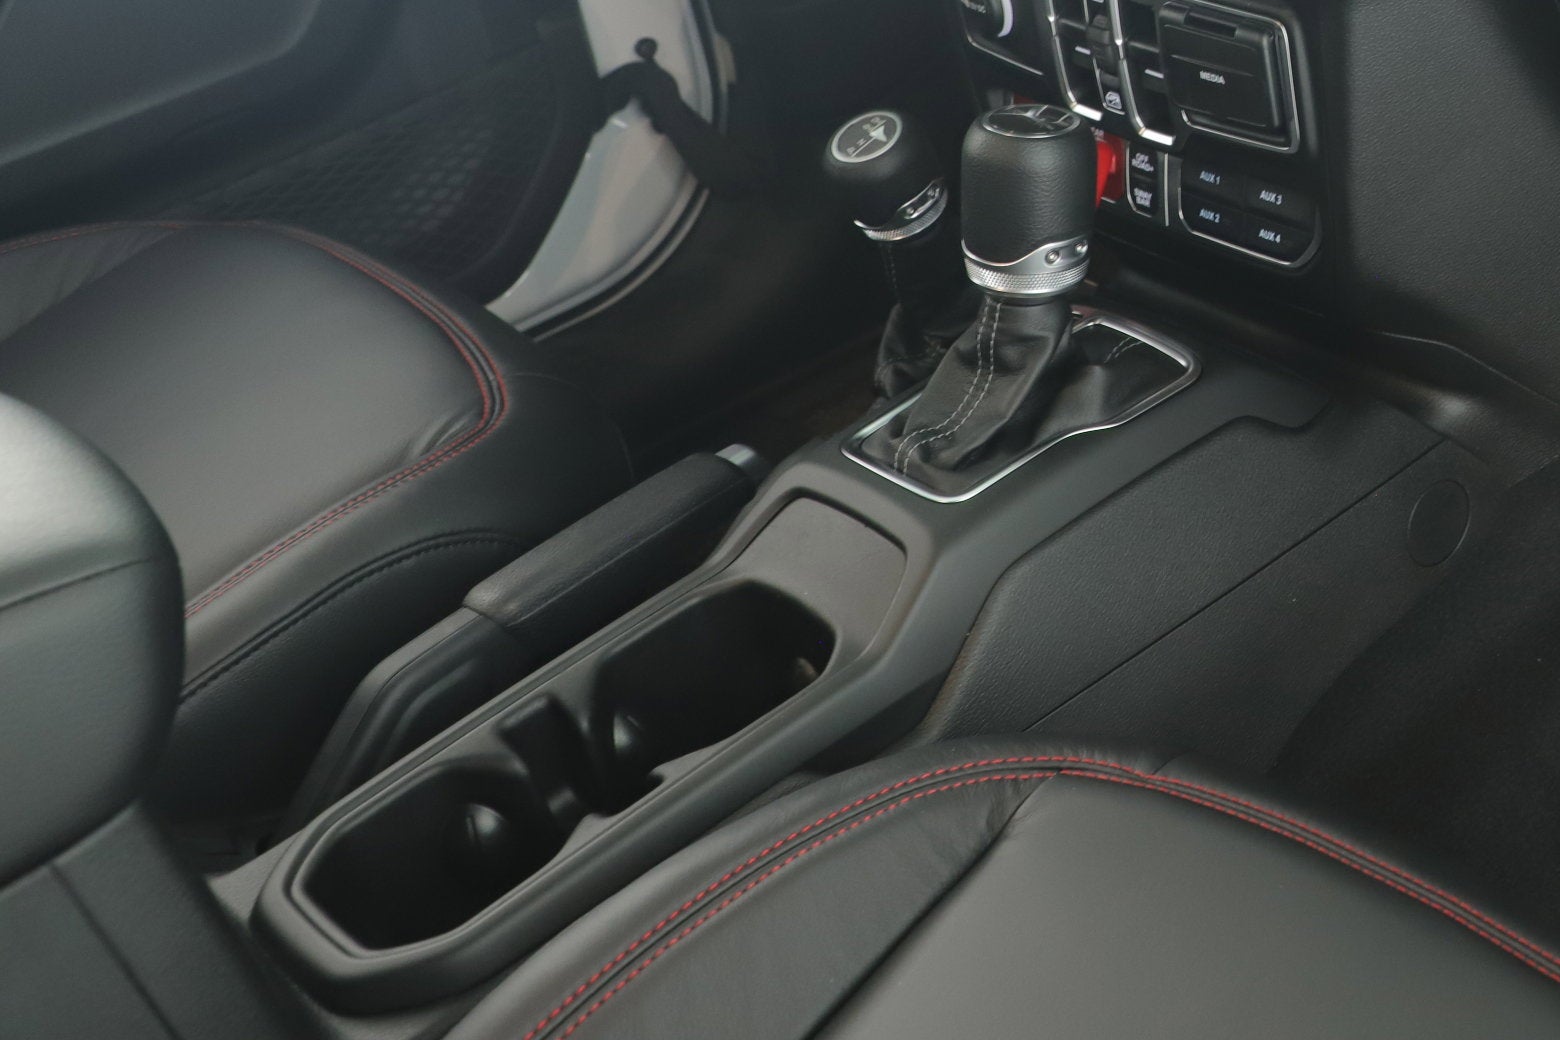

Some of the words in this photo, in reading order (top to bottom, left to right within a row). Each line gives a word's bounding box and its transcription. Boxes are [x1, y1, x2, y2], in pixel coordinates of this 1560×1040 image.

[1200, 170, 1215, 183] AUX
[1215, 175, 1220, 185] 1
[1259, 189, 1276, 203] AUX
[1276, 194, 1282, 205] 3
[1199, 208, 1214, 221] AUX
[1214, 213, 1220, 223] 2
[1259, 228, 1275, 242] AUX
[1275, 233, 1281, 243] 4
